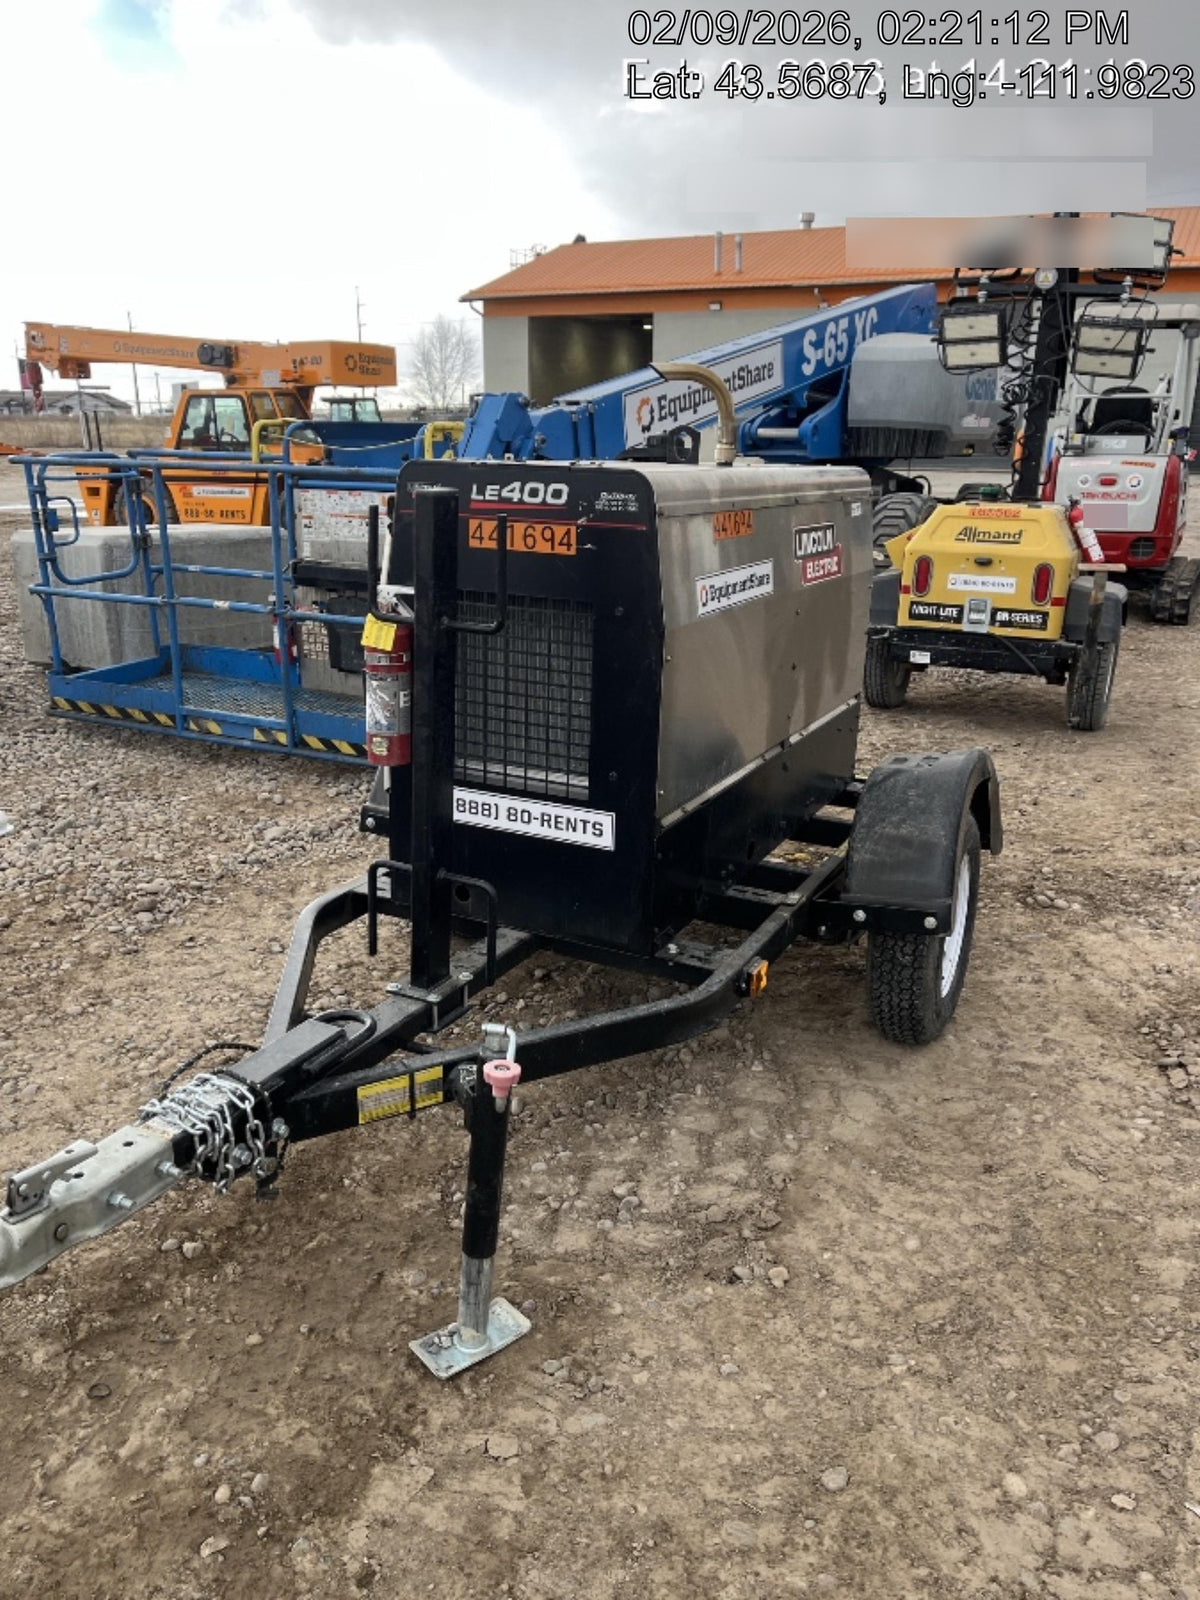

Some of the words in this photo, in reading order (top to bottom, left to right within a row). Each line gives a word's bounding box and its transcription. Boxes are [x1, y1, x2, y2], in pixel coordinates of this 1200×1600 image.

[801, 316, 849, 376] S-65
[853, 306, 878, 347] XC
[470, 481, 569, 505] LE400
[470, 521, 573, 552] 441694
[795, 527, 834, 556] LINCOLN
[955, 525, 1023, 544] Allmand
[806, 556, 839, 579] ELECTRIC
[709, 571, 771, 603] EquipmentShare
[506, 806, 605, 838] 80-RENTS
